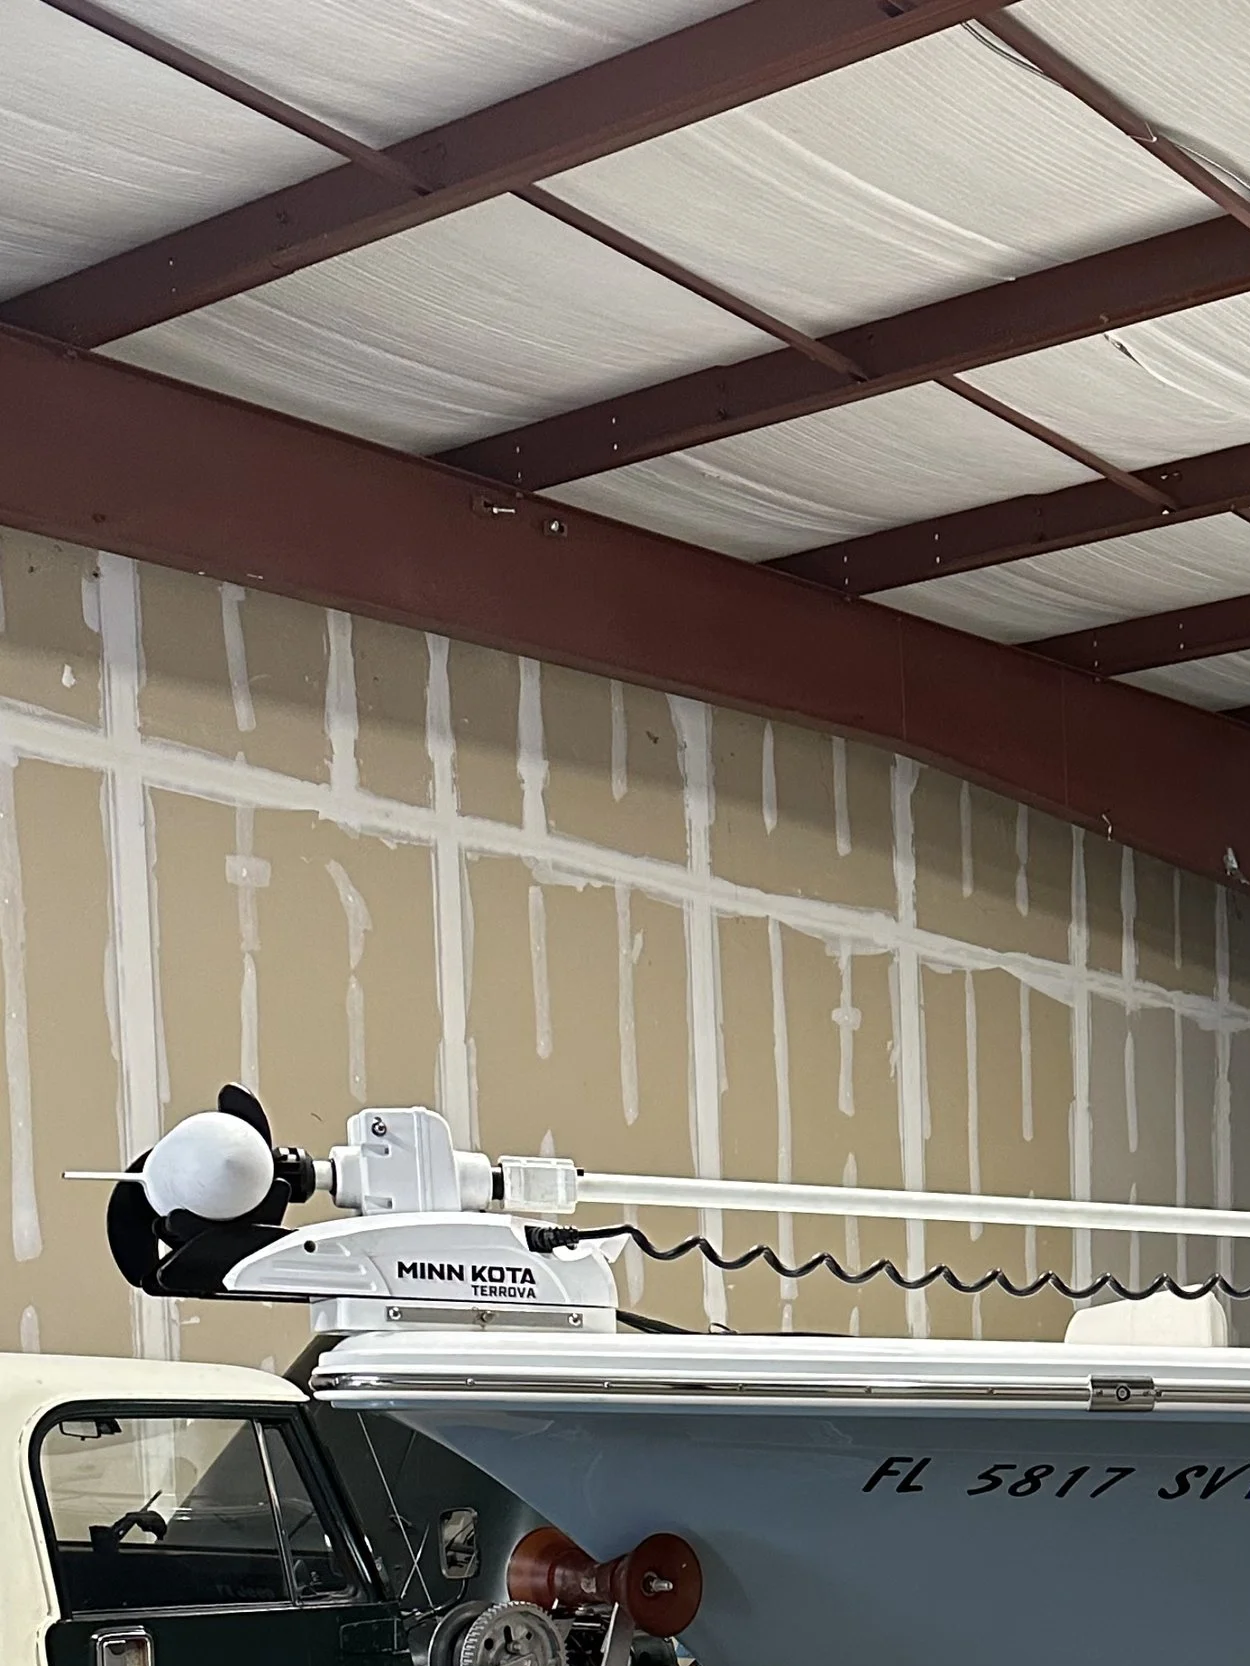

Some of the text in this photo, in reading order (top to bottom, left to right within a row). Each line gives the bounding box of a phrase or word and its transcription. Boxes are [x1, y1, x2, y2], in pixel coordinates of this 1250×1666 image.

[397, 1261, 536, 1285] MINN KOTA
[471, 1284, 536, 1299] TERROVA
[862, 1456, 932, 1493] FL
[966, 1463, 1136, 1498] 5817
